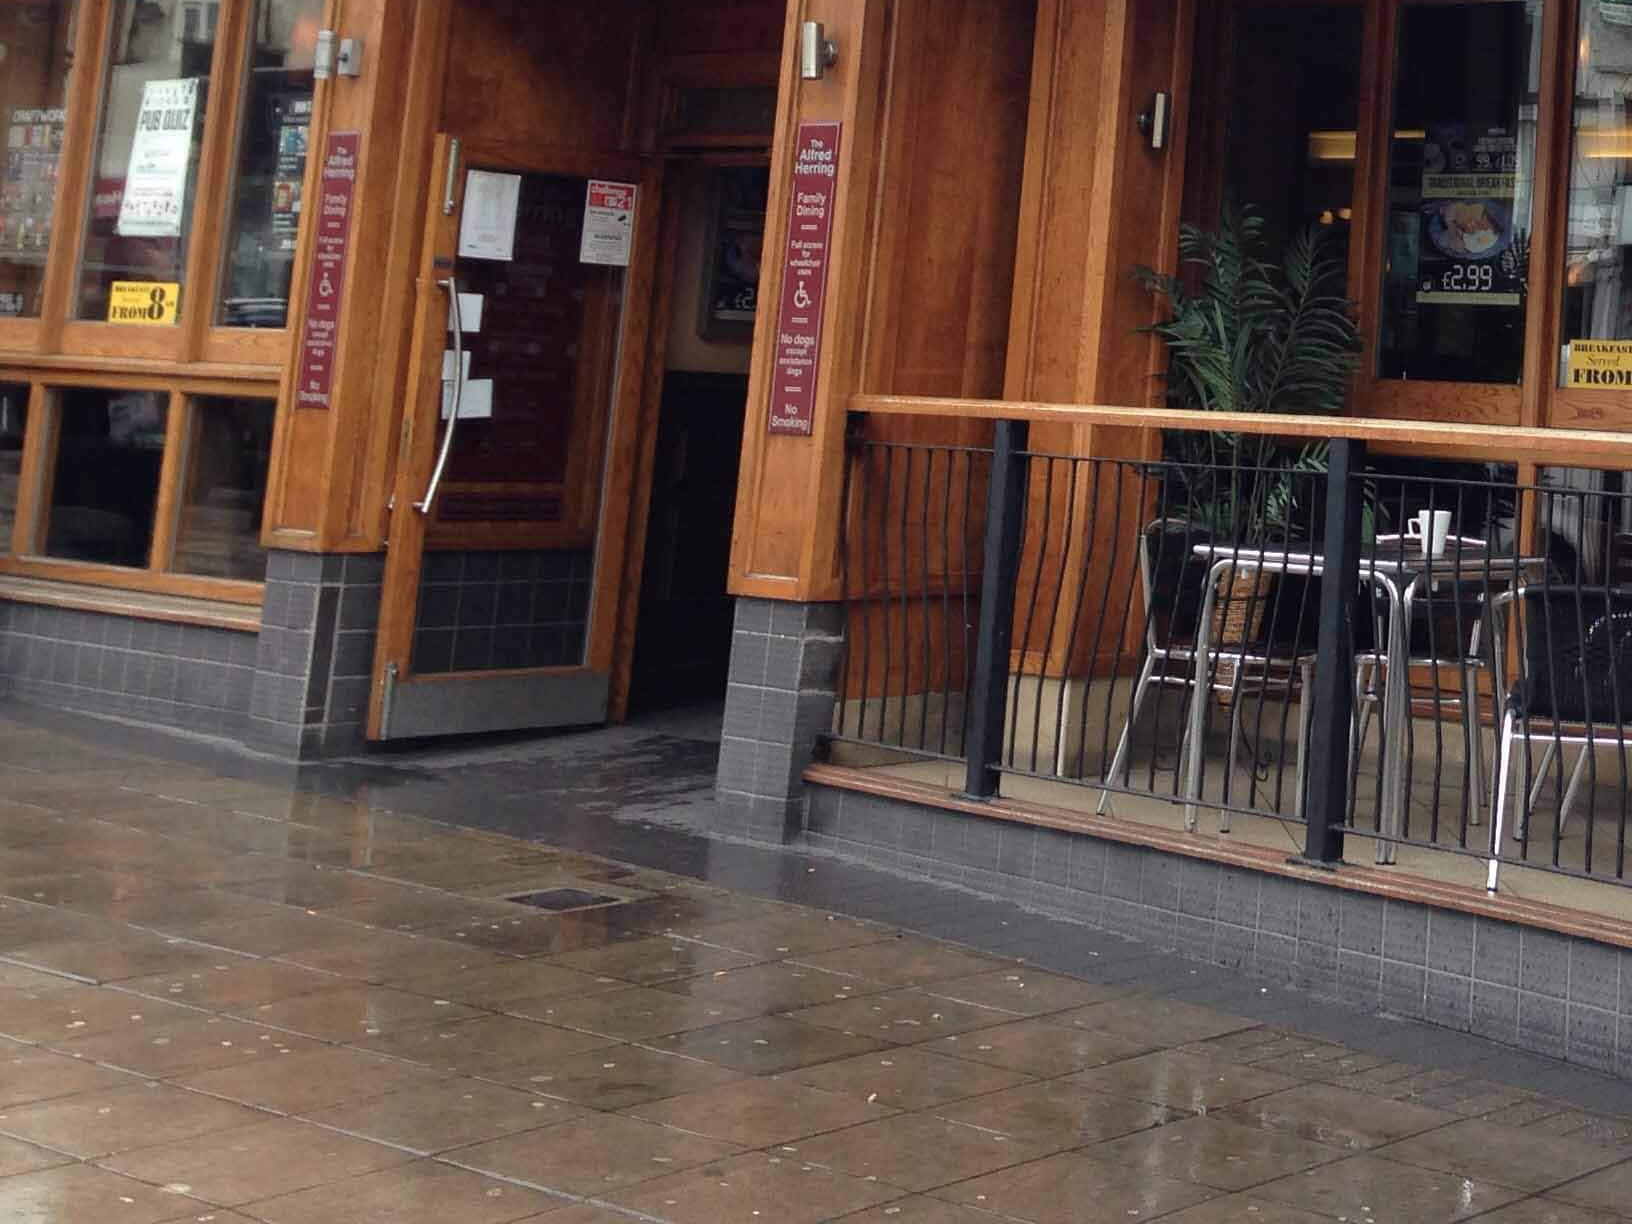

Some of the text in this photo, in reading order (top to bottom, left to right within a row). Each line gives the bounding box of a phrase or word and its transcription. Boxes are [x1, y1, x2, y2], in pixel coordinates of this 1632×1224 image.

[141, 108, 191, 132] PUB QUIZ
[810, 138, 824, 149] The
[799, 149, 833, 162] Alfred
[794, 160, 835, 177] Herring
[797, 191, 827, 206] Family
[796, 205, 825, 219] Dining
[1442, 264, 1493, 291] £2.99
[147, 286, 167, 321] 8
[780, 333, 816, 349] No dogs
[1573, 343, 1632, 354] BREAKFAST
[1572, 367, 1632, 386] FROM
[784, 403, 798, 416] No
[771, 415, 809, 431] Smoking
